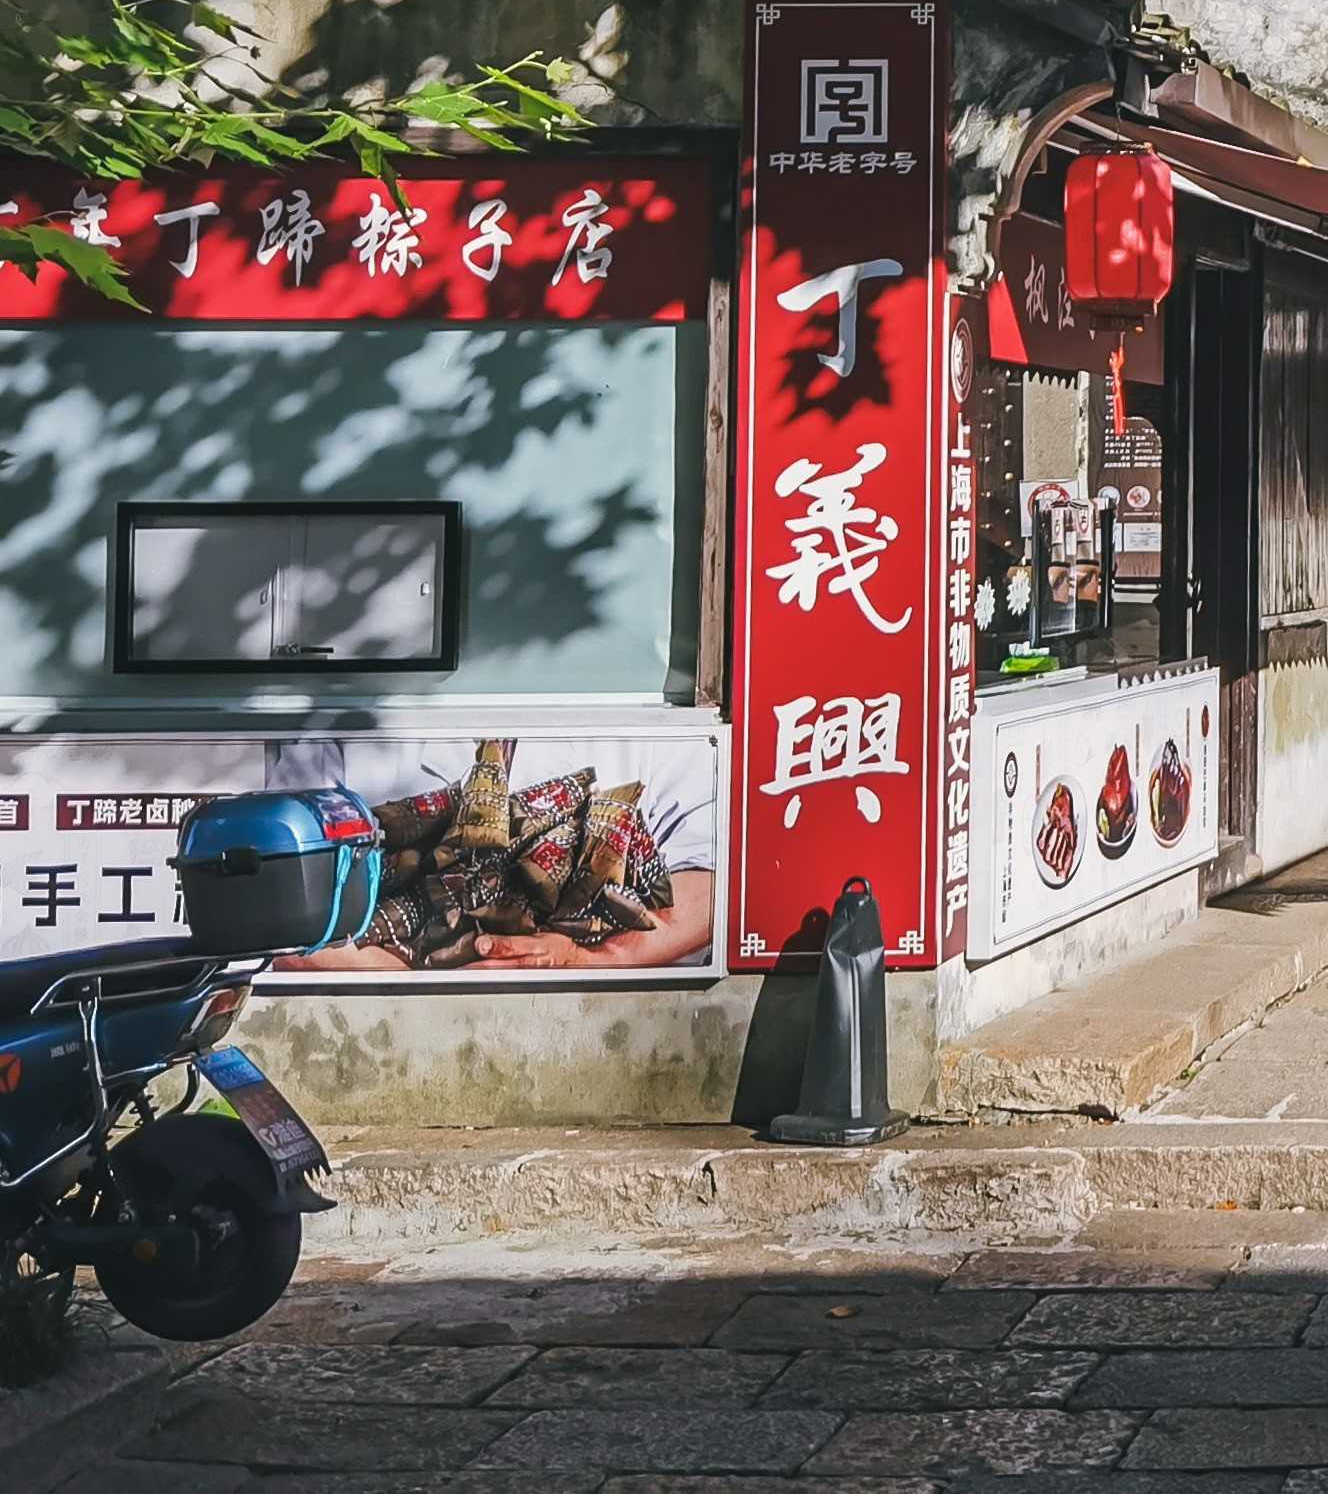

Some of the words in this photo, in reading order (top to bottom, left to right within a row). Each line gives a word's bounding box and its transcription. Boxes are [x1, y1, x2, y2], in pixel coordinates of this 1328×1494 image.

[769, 151, 917, 175] 中华老字号
[0, 187, 614, 286] 年丁蹄粽子店
[1024, 254, 1096, 340] 枫泾
[945, 412, 974, 938] 上海市非物质文化遗产
[67, 798, 202, 826] 丁蹄老卤秘
[22, 863, 190, 927] 手工
